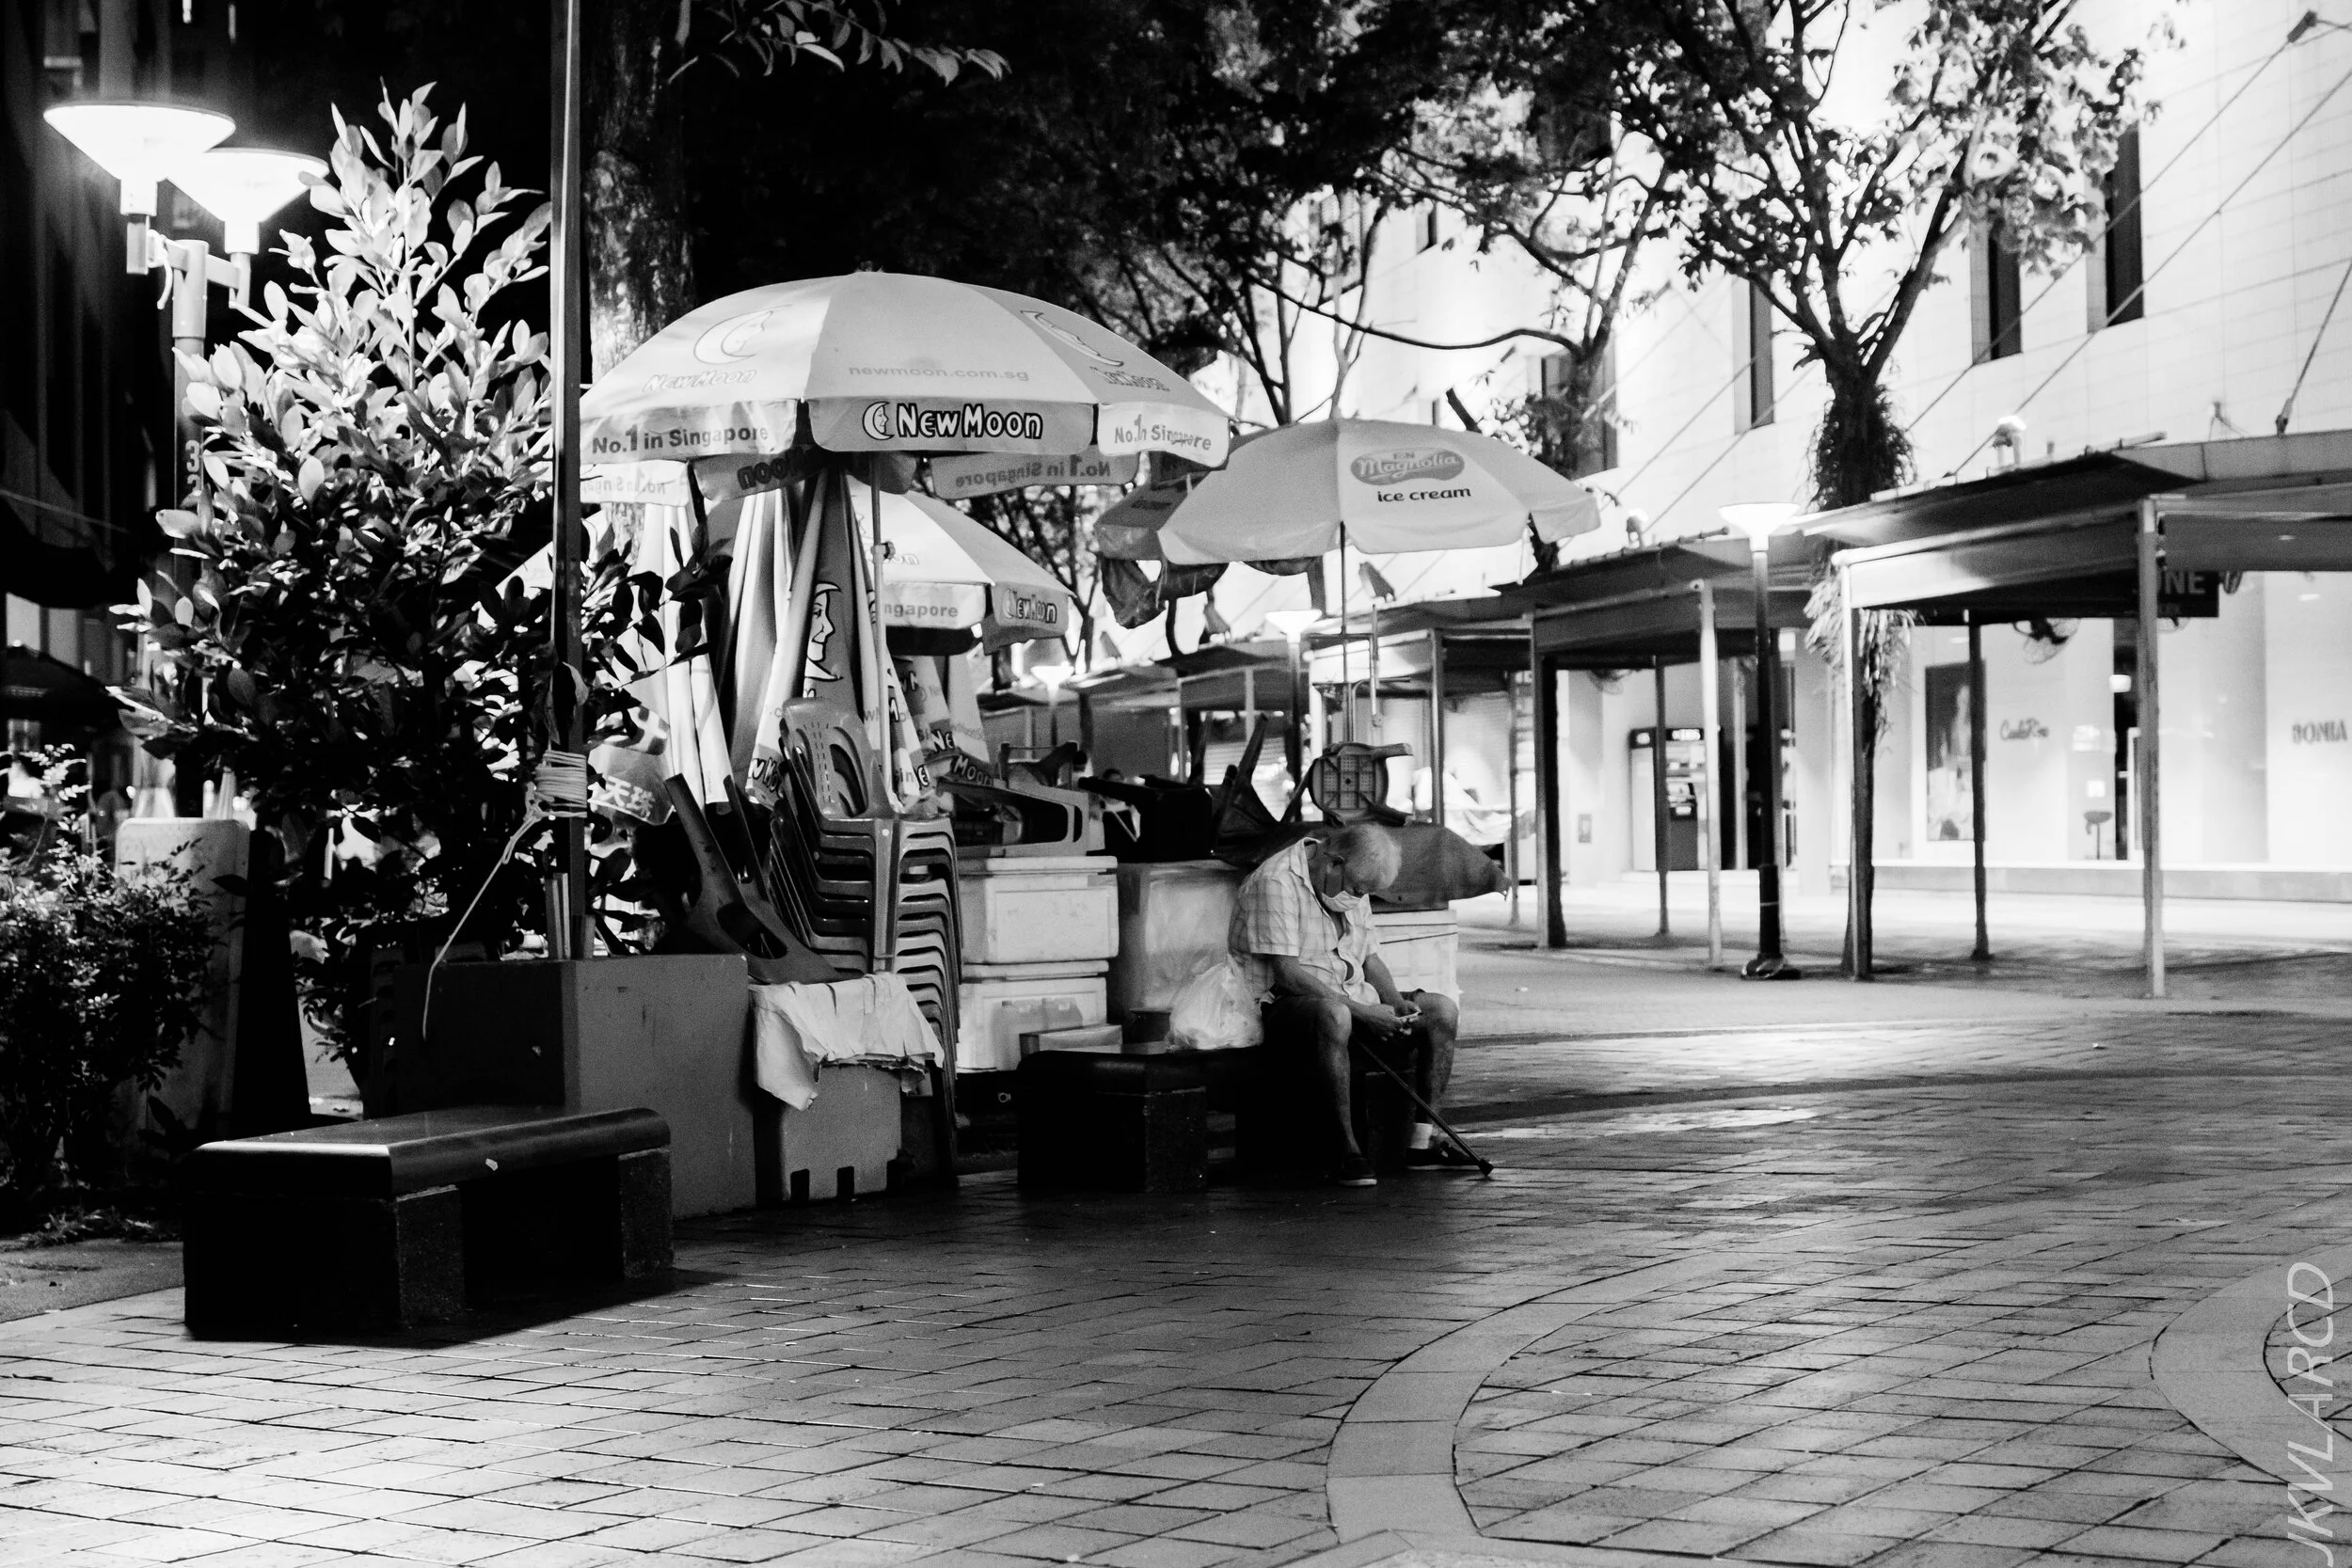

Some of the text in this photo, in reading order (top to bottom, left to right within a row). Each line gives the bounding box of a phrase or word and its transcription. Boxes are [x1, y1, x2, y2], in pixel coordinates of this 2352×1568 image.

[849, 365, 1030, 382] newmoon.com.sg
[896, 403, 1043, 439] NewMoon
[592, 423, 769, 453] No.1 in Singapore
[1358, 452, 1458, 479] Magnolia
[1376, 488, 1471, 502] ice cream
[883, 602, 959, 623] ngapore
